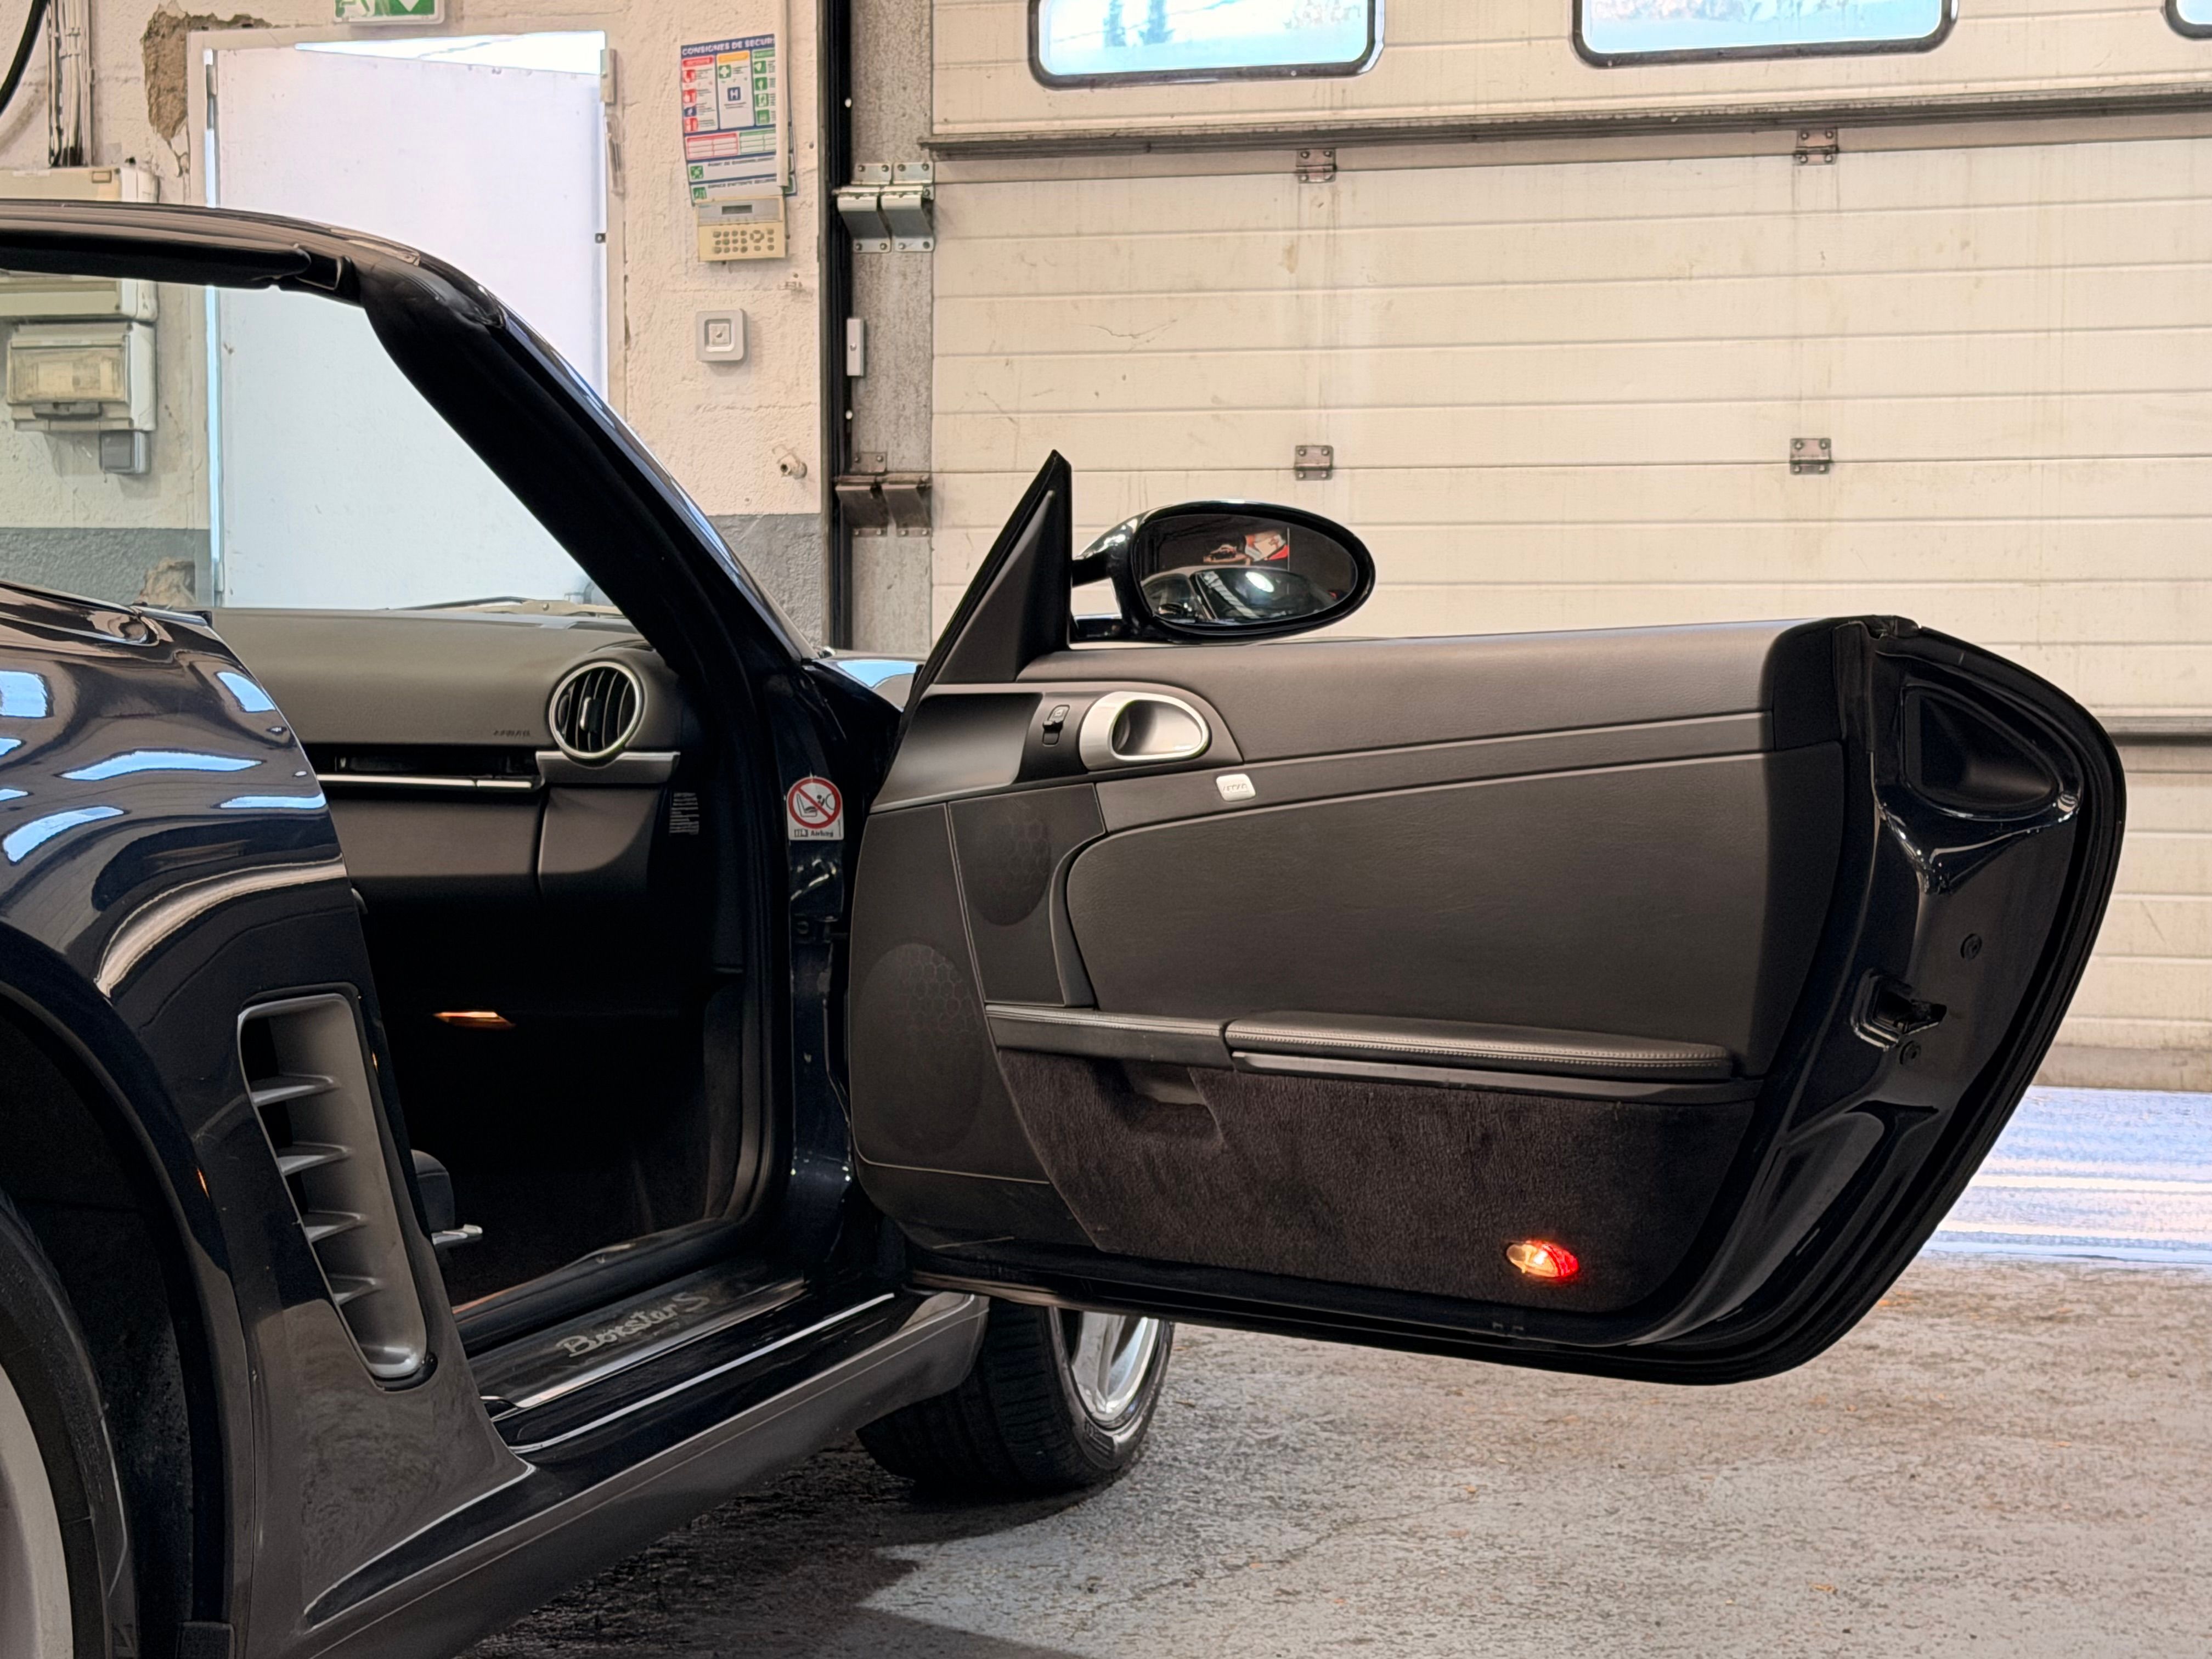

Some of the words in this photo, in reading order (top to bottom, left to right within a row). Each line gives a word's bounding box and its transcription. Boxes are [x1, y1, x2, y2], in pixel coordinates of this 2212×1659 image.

[682, 42, 730, 55] CONSIGNES
[731, 41, 743, 49] DE
[555, 1304, 678, 1358] Boxster
[671, 1292, 710, 1312] S
